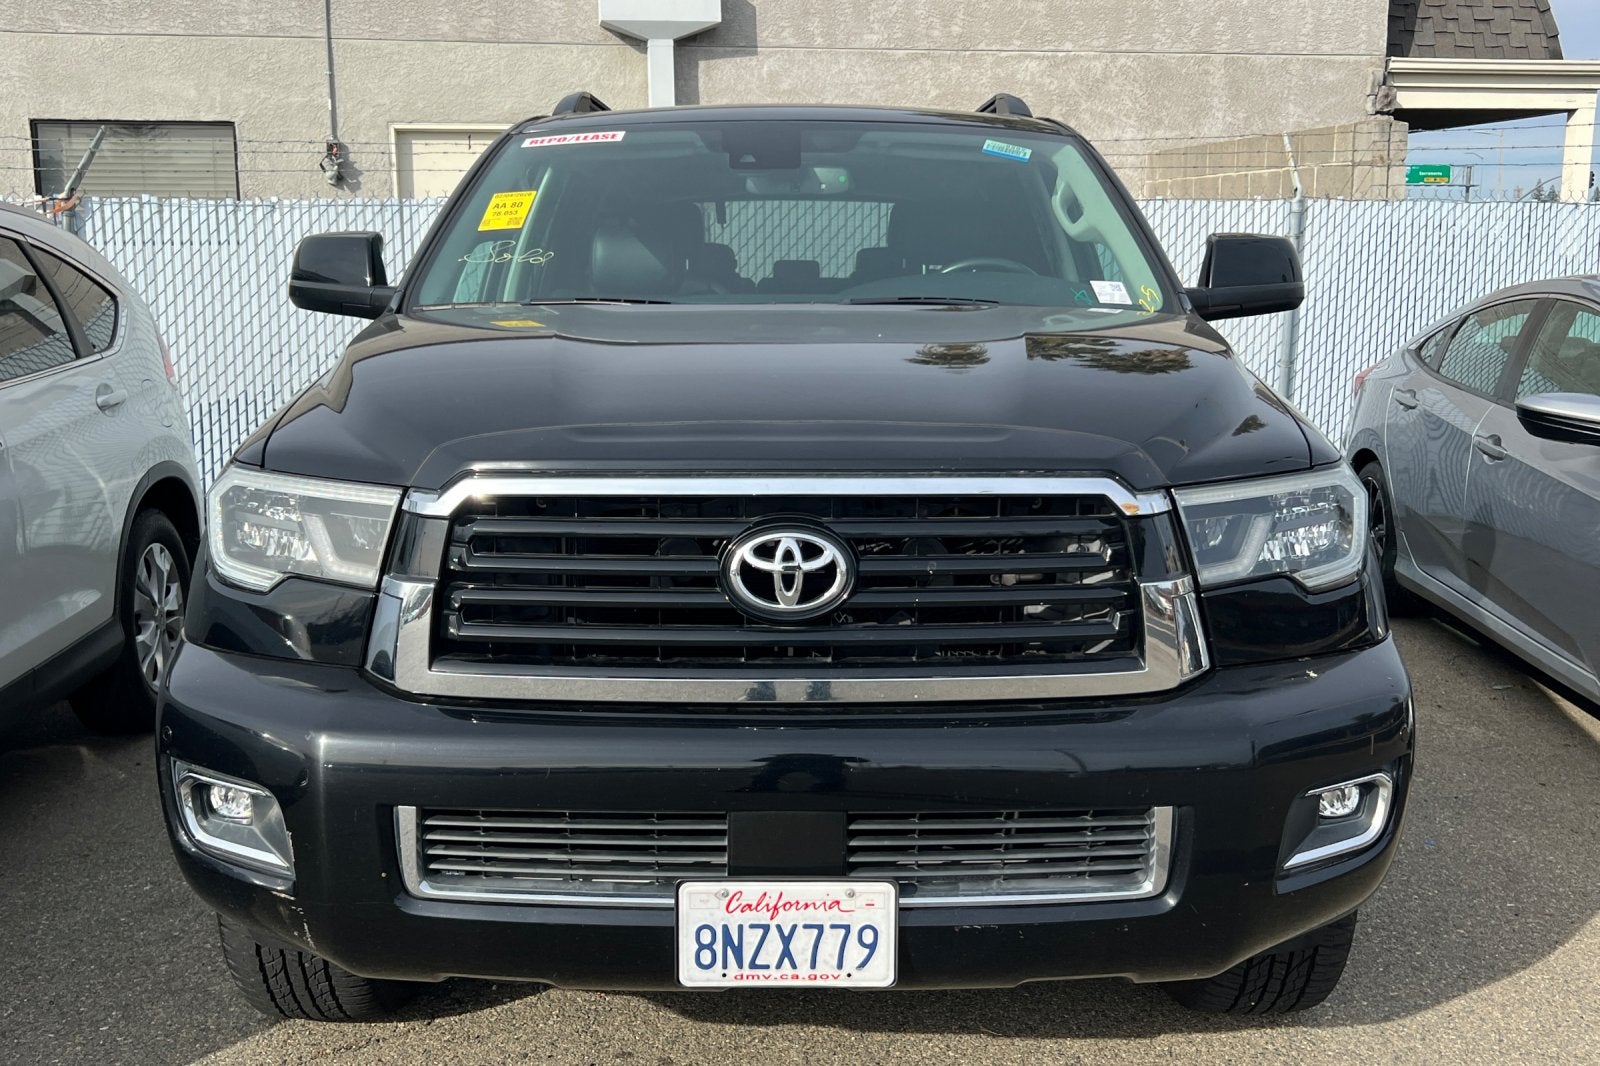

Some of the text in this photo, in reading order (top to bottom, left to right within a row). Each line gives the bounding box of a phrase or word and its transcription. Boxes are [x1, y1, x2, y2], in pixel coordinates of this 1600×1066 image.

[529, 133, 618, 145] REPO/LEASE
[492, 201, 524, 210] AA 80
[725, 890, 856, 921] California
[694, 923, 879, 971] 8NZX779
[733, 972, 842, 982] dmv.ca.gov
